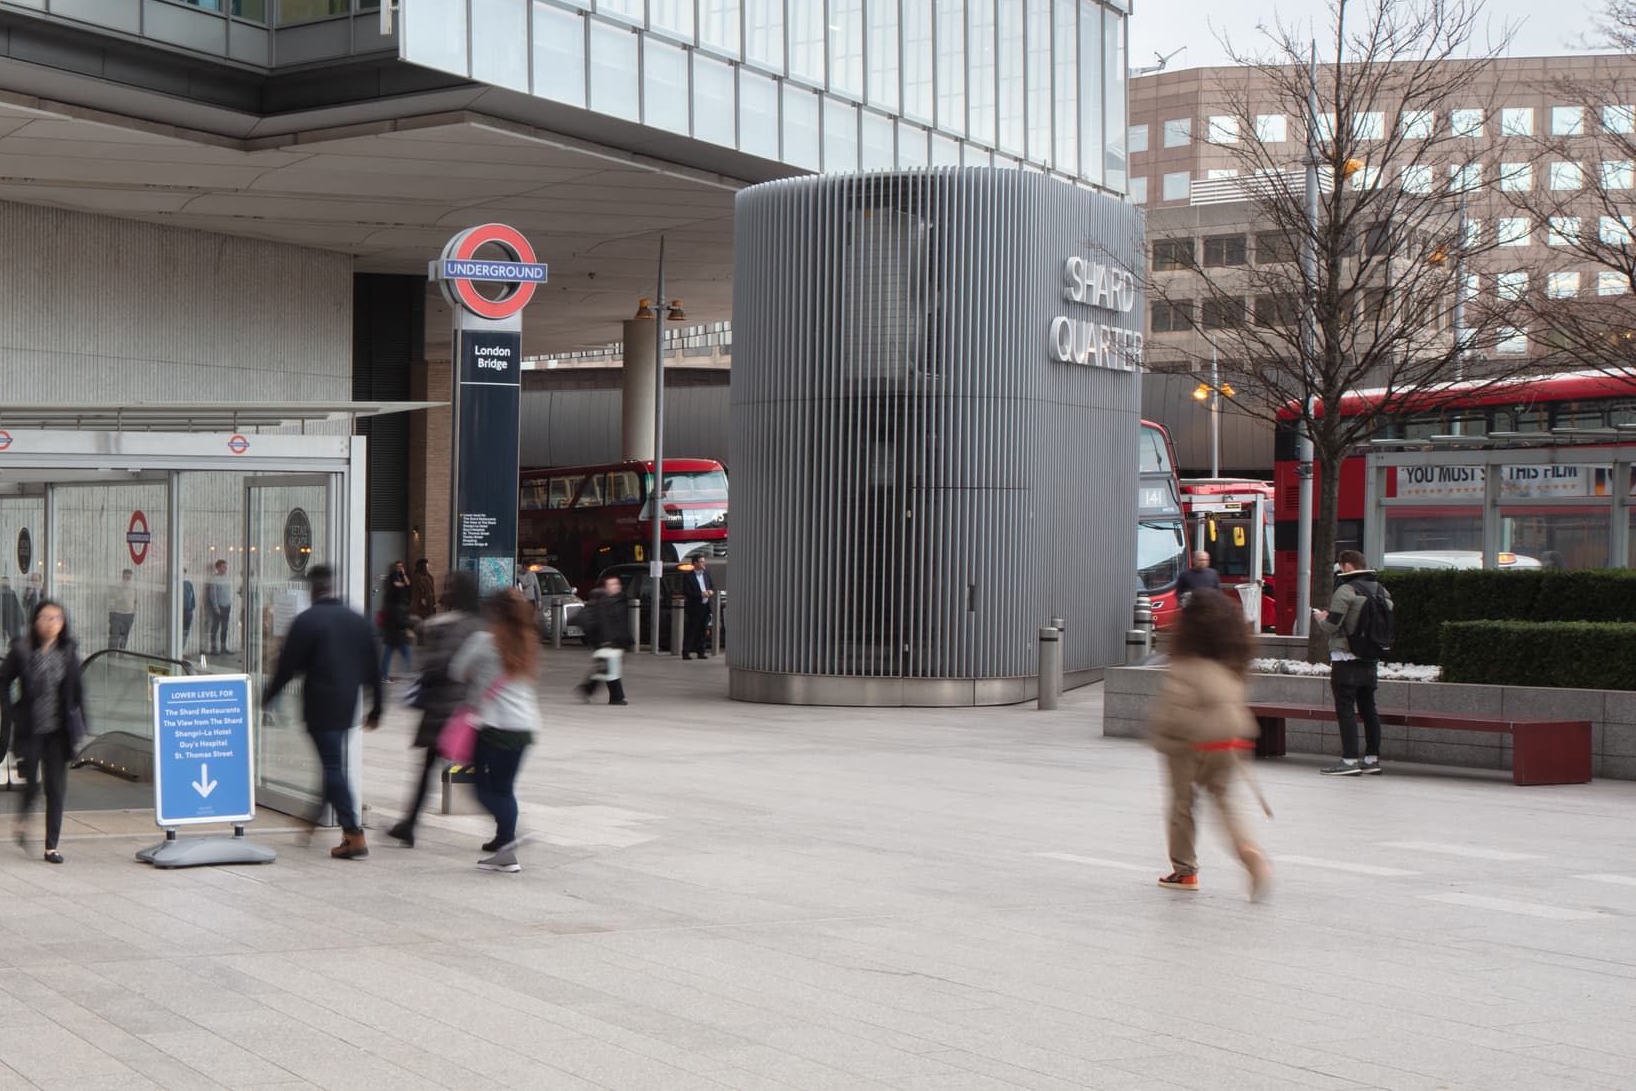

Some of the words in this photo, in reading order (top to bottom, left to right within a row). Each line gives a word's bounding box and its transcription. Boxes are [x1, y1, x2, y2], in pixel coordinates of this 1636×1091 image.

[447, 263, 543, 279] UNDERGROUND
[1066, 257, 1134, 312] SHARD
[474, 345, 511, 357] London
[1052, 316, 1143, 373] QUARTER
[477, 357, 508, 371] Bridge
[1146, 491, 1162, 504] 141
[172, 691, 196, 699] LOWER
[198, 690, 218, 698] LEVEL
[200, 739, 228, 747] Hospital
